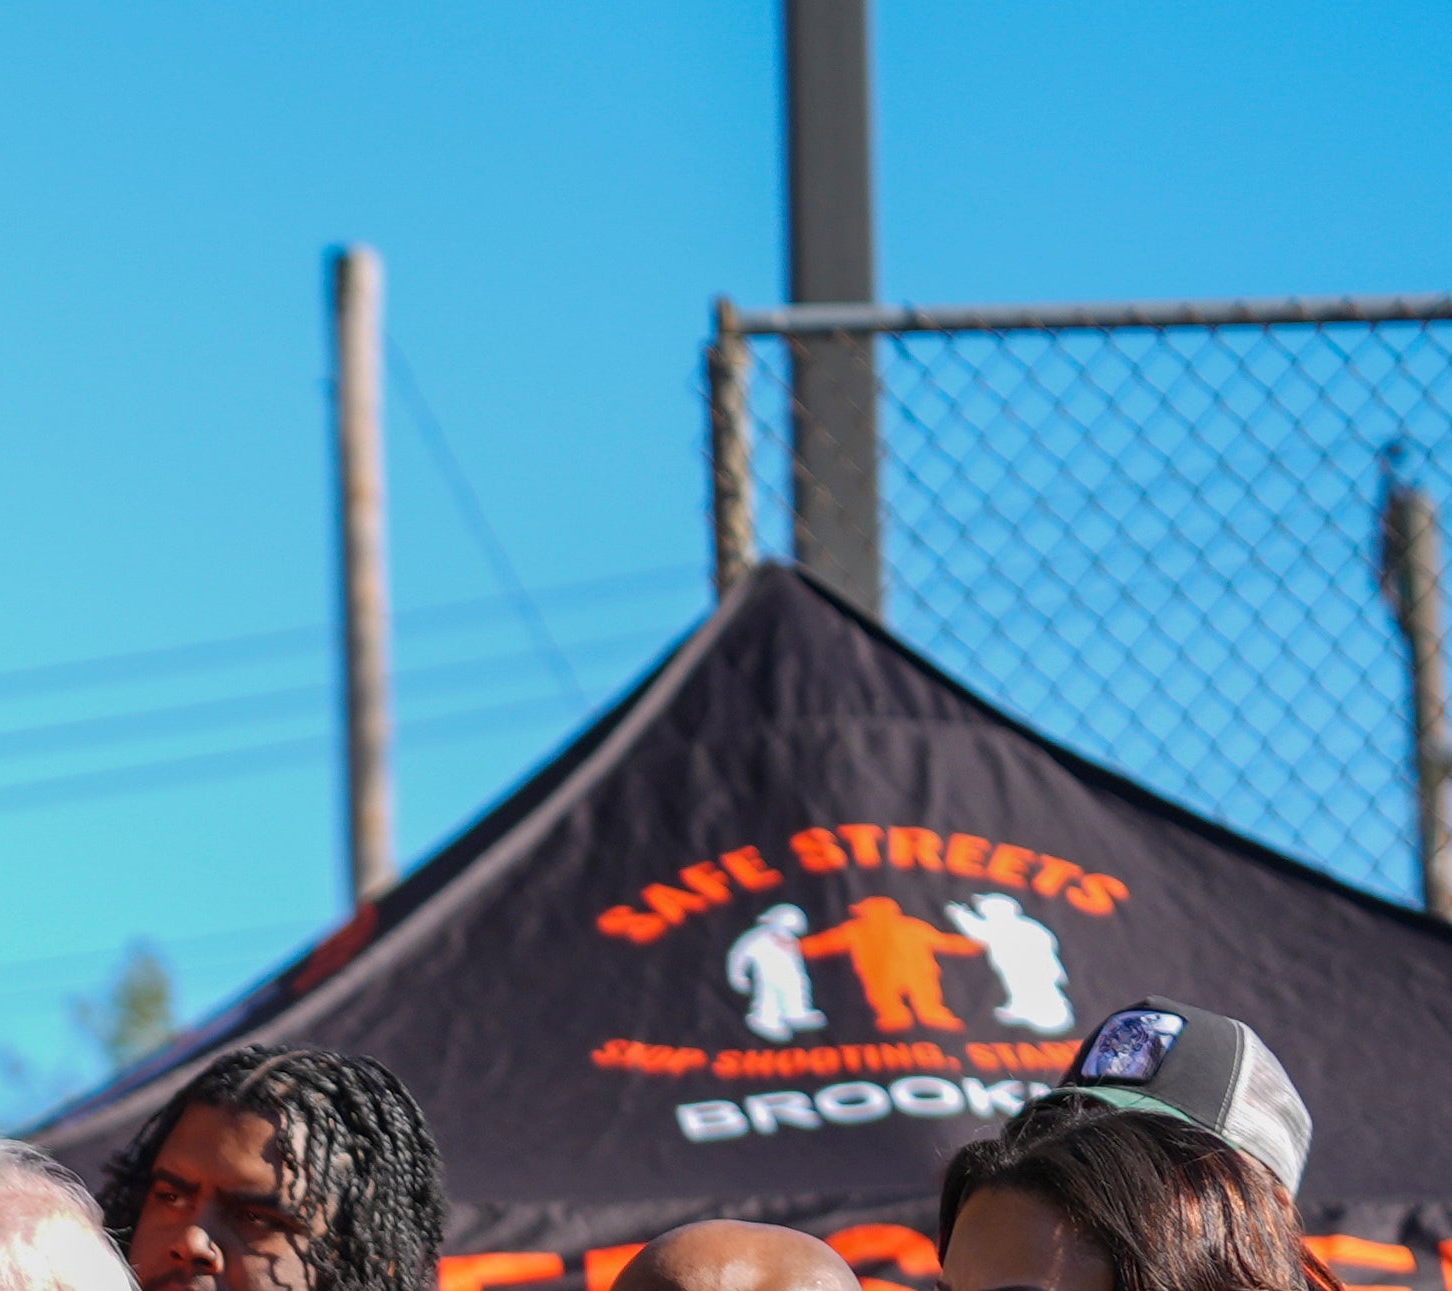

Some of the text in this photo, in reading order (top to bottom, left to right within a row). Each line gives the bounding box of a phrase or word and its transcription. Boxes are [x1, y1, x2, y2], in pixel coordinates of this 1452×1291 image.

[596, 823, 1131, 943] SAFE STREETS
[676, 1076, 1052, 1144] BROOK
